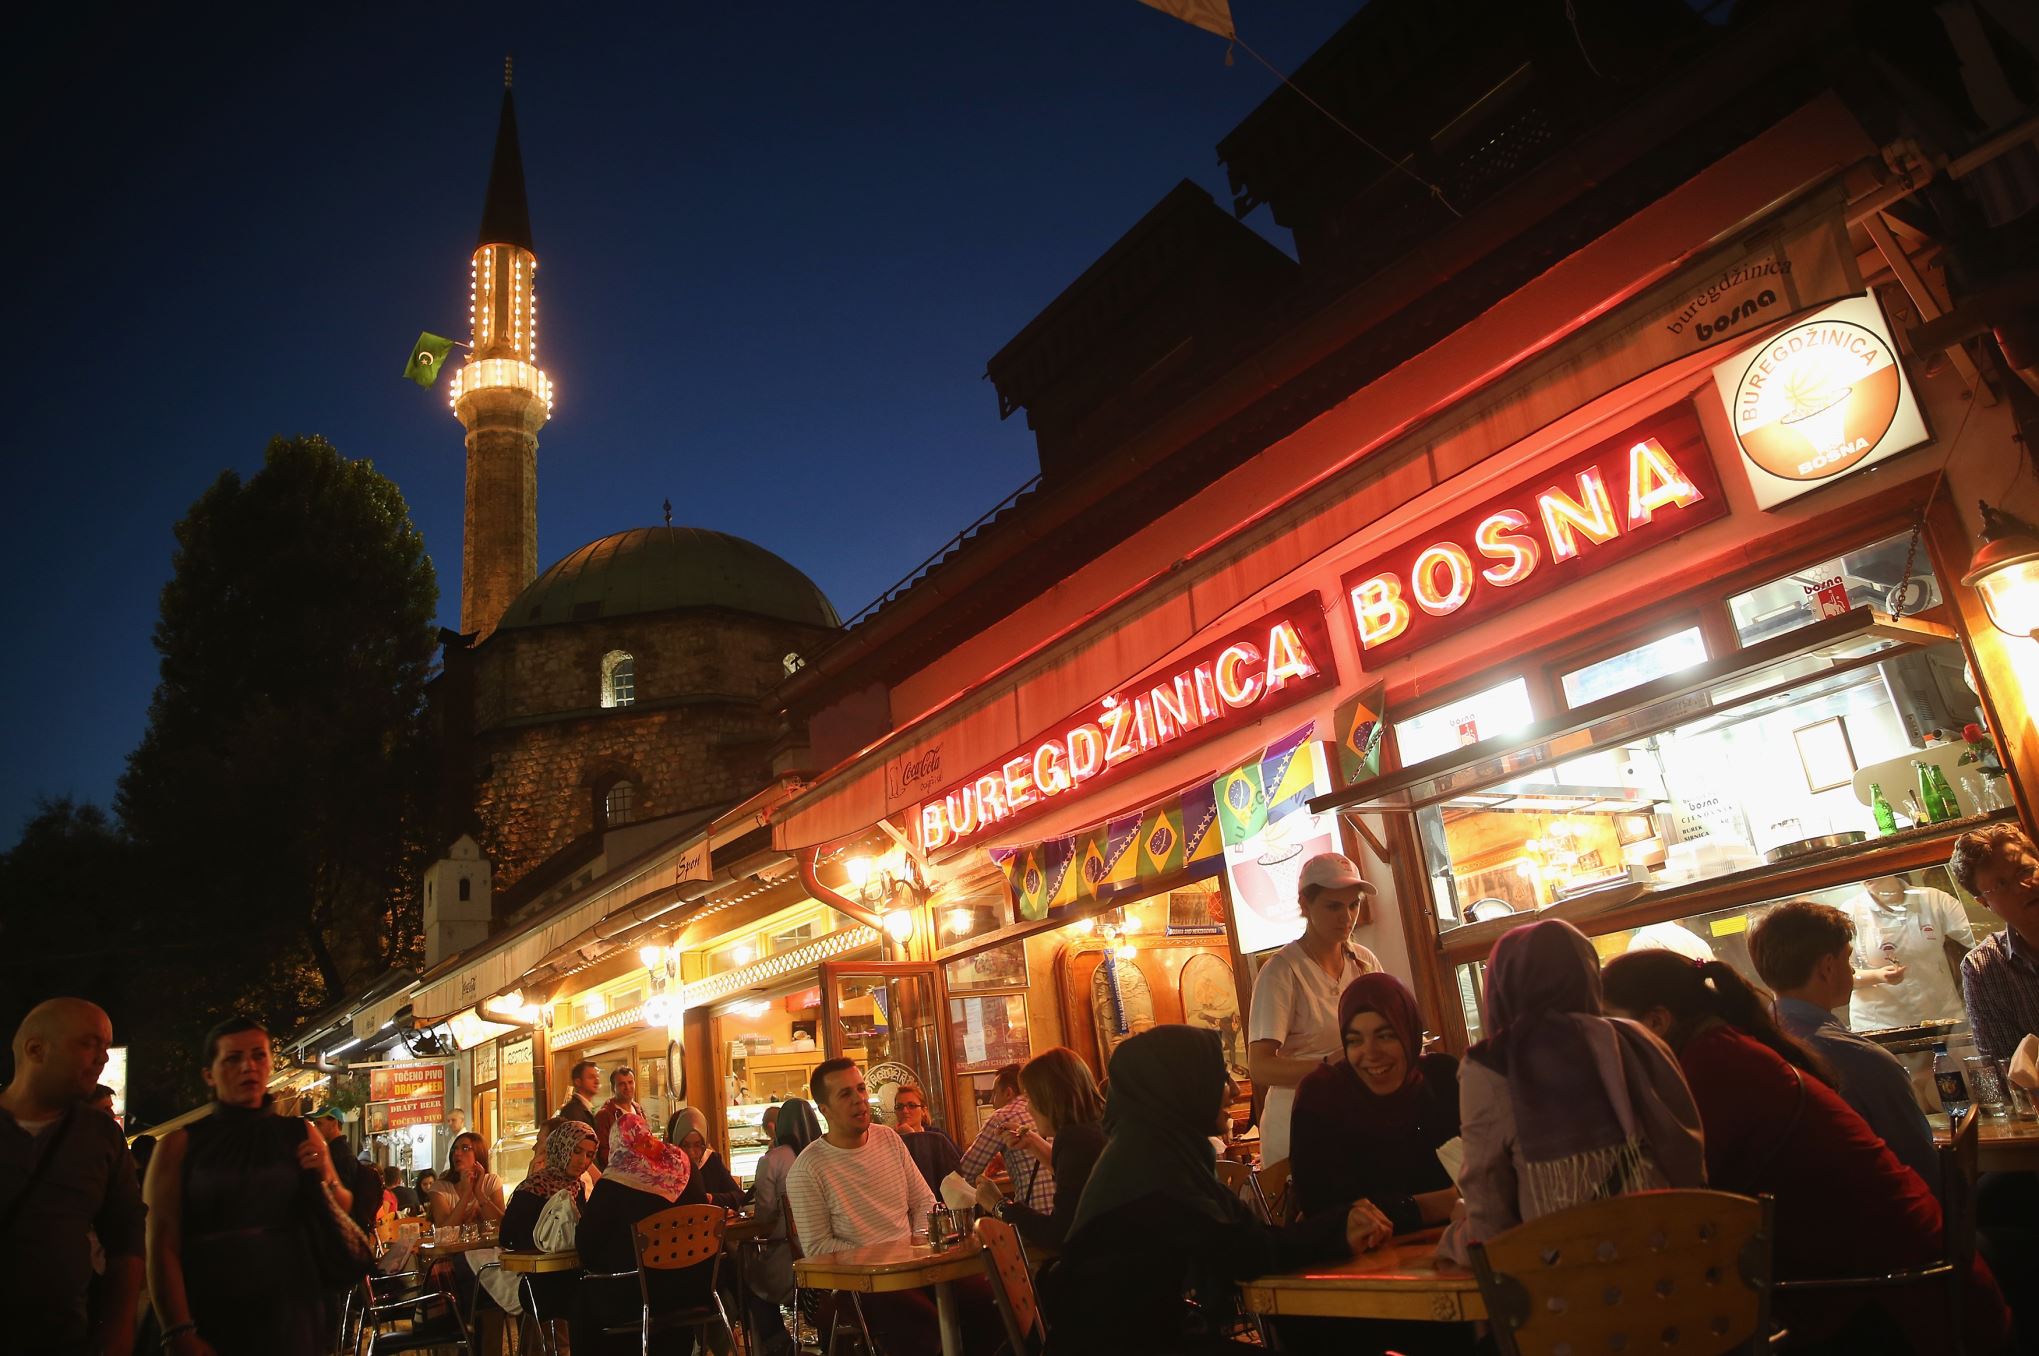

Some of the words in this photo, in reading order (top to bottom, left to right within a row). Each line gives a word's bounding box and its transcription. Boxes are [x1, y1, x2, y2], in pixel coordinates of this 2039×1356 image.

[1667, 258, 1792, 334] buregdžinica
[1695, 289, 1777, 341] bosna
[1742, 328, 1878, 421] BUREGDŽINICA
[1797, 437, 1870, 475] BOSNA
[1804, 576, 1842, 594] bosna
[920, 618, 1320, 849] BUREGDŽINICA
[1350, 436, 1704, 651] BOSNA
[1449, 713, 1476, 727] bosna
[1688, 798, 1719, 811] bosna
[1682, 825, 1703, 835] BUREK
[394, 1070, 424, 1083] TOČENO
[424, 1069, 443, 1080] PIVO
[394, 1082, 421, 1096] DRAFT
[390, 1103, 417, 1113] DRAFT
[420, 1100, 441, 1109] BEER
[424, 1113, 442, 1122] PIVO
